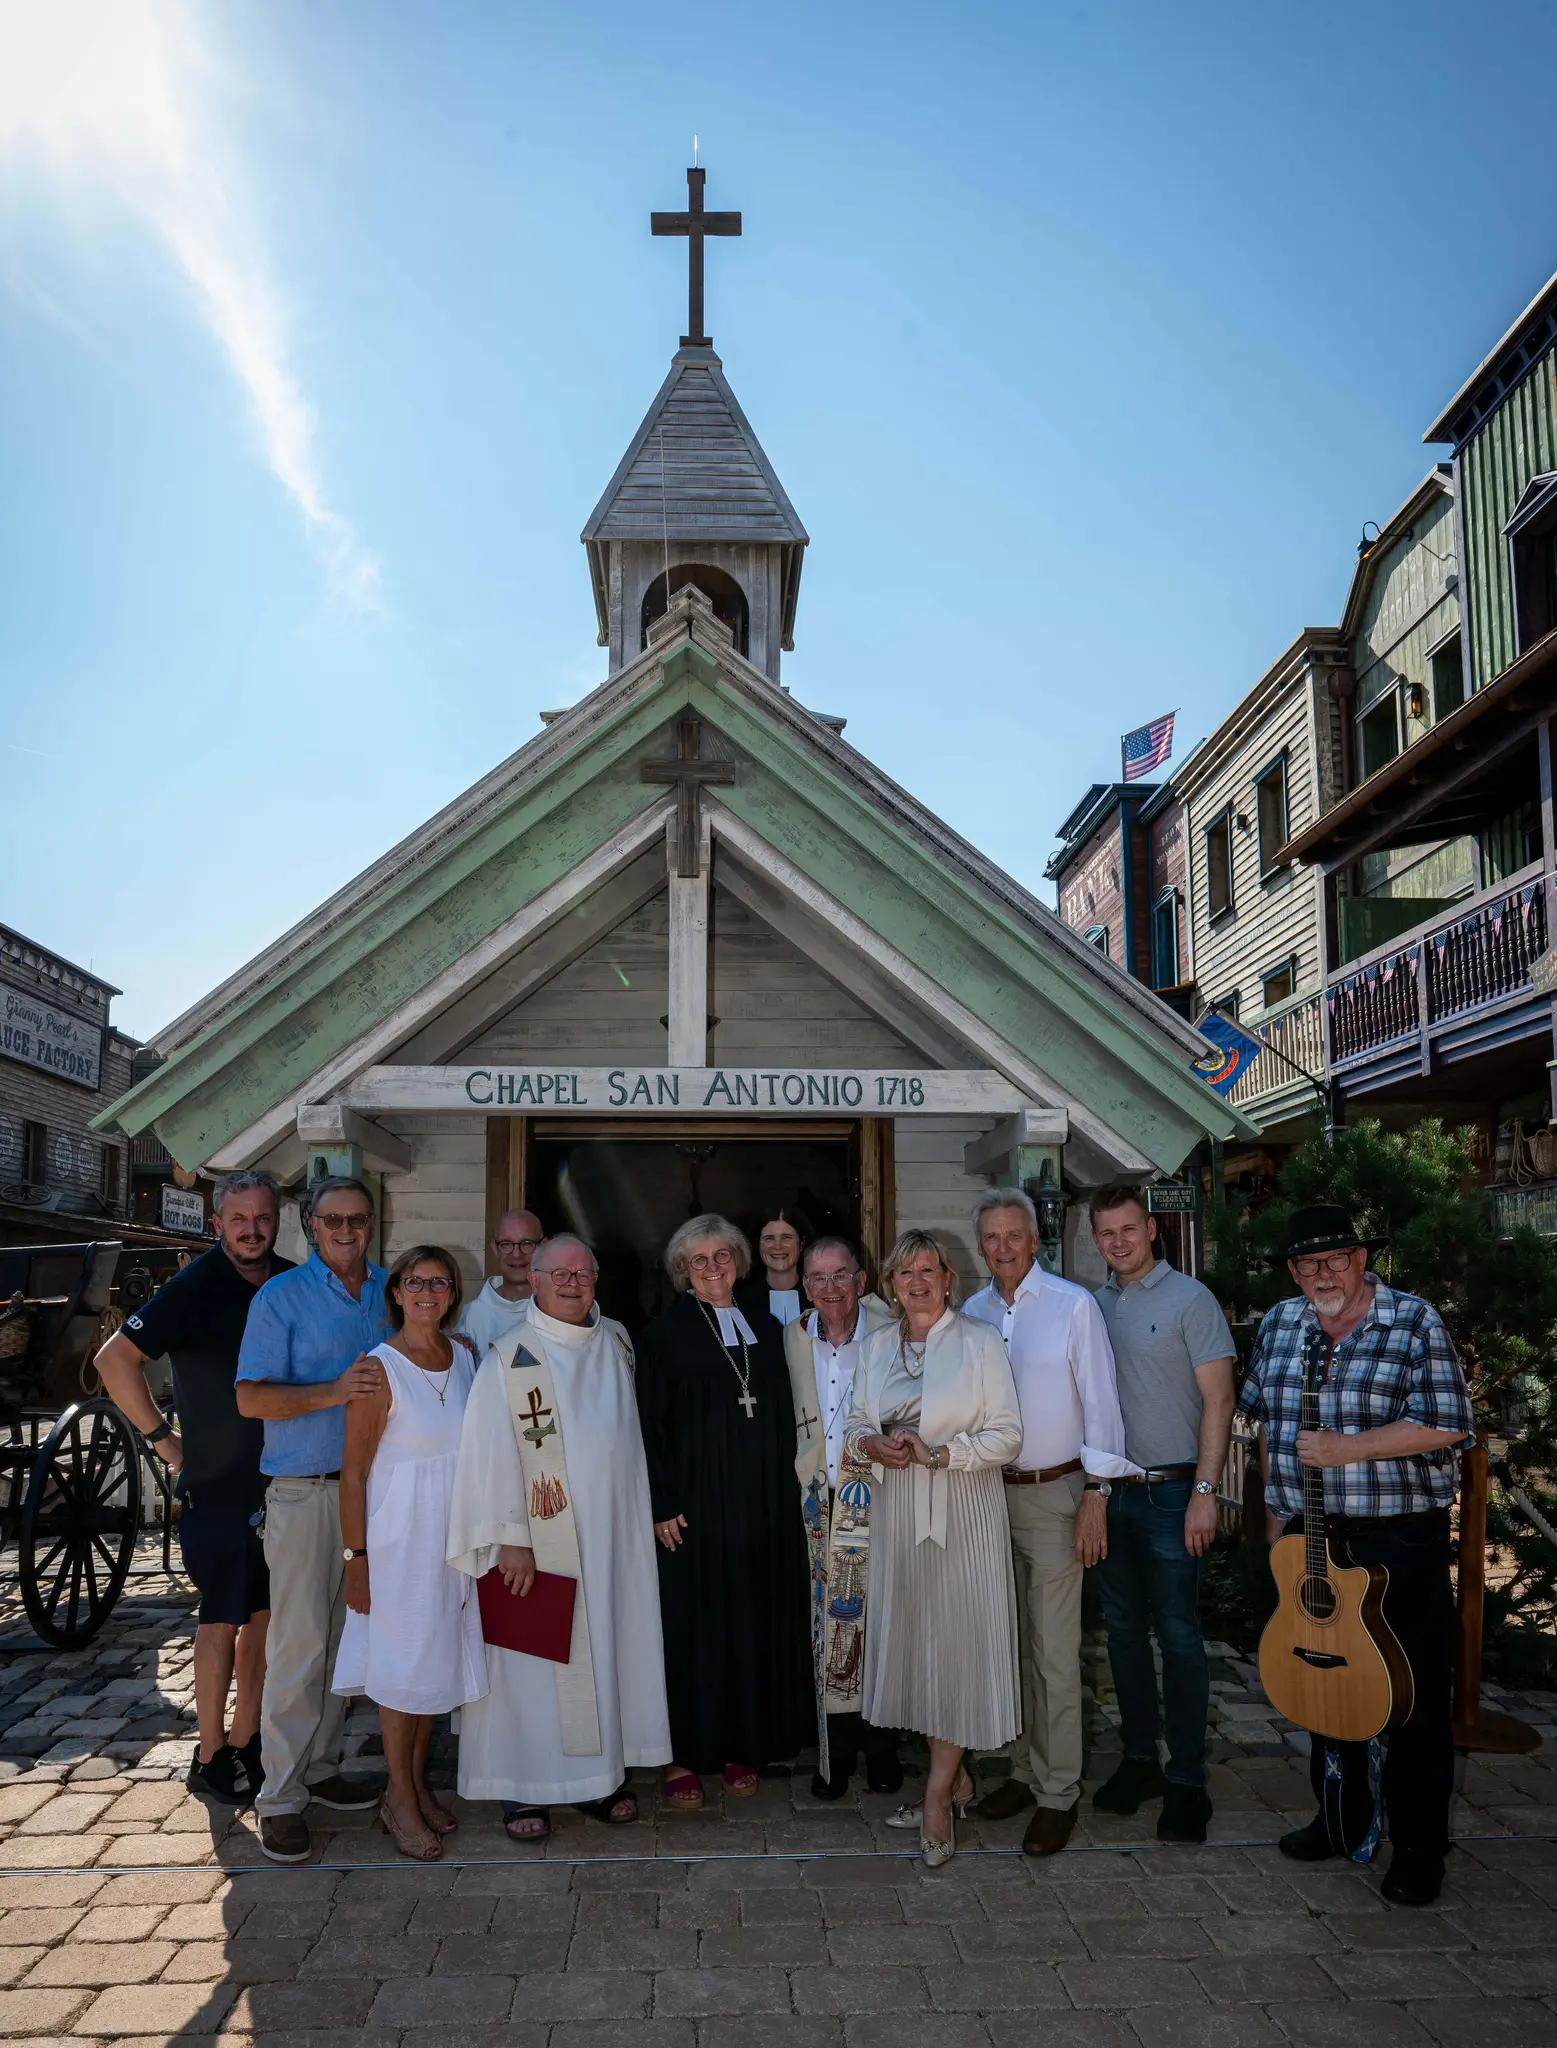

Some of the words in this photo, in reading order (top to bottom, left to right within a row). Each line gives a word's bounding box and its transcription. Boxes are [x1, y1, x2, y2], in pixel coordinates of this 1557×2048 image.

[5, 995, 44, 1033] Granny
[0, 1023, 30, 1057] UCE
[37, 1039, 93, 1081] FACTORY
[464, 1070, 588, 1105] CHAPEL
[608, 1070, 680, 1106] SAN
[702, 1070, 864, 1106] ANTONIO
[874, 1076, 925, 1107] 1718
[164, 1209, 180, 1225] HOT
[182, 1213, 202, 1230] DOGS
[126, 1315, 144, 1330] ED
